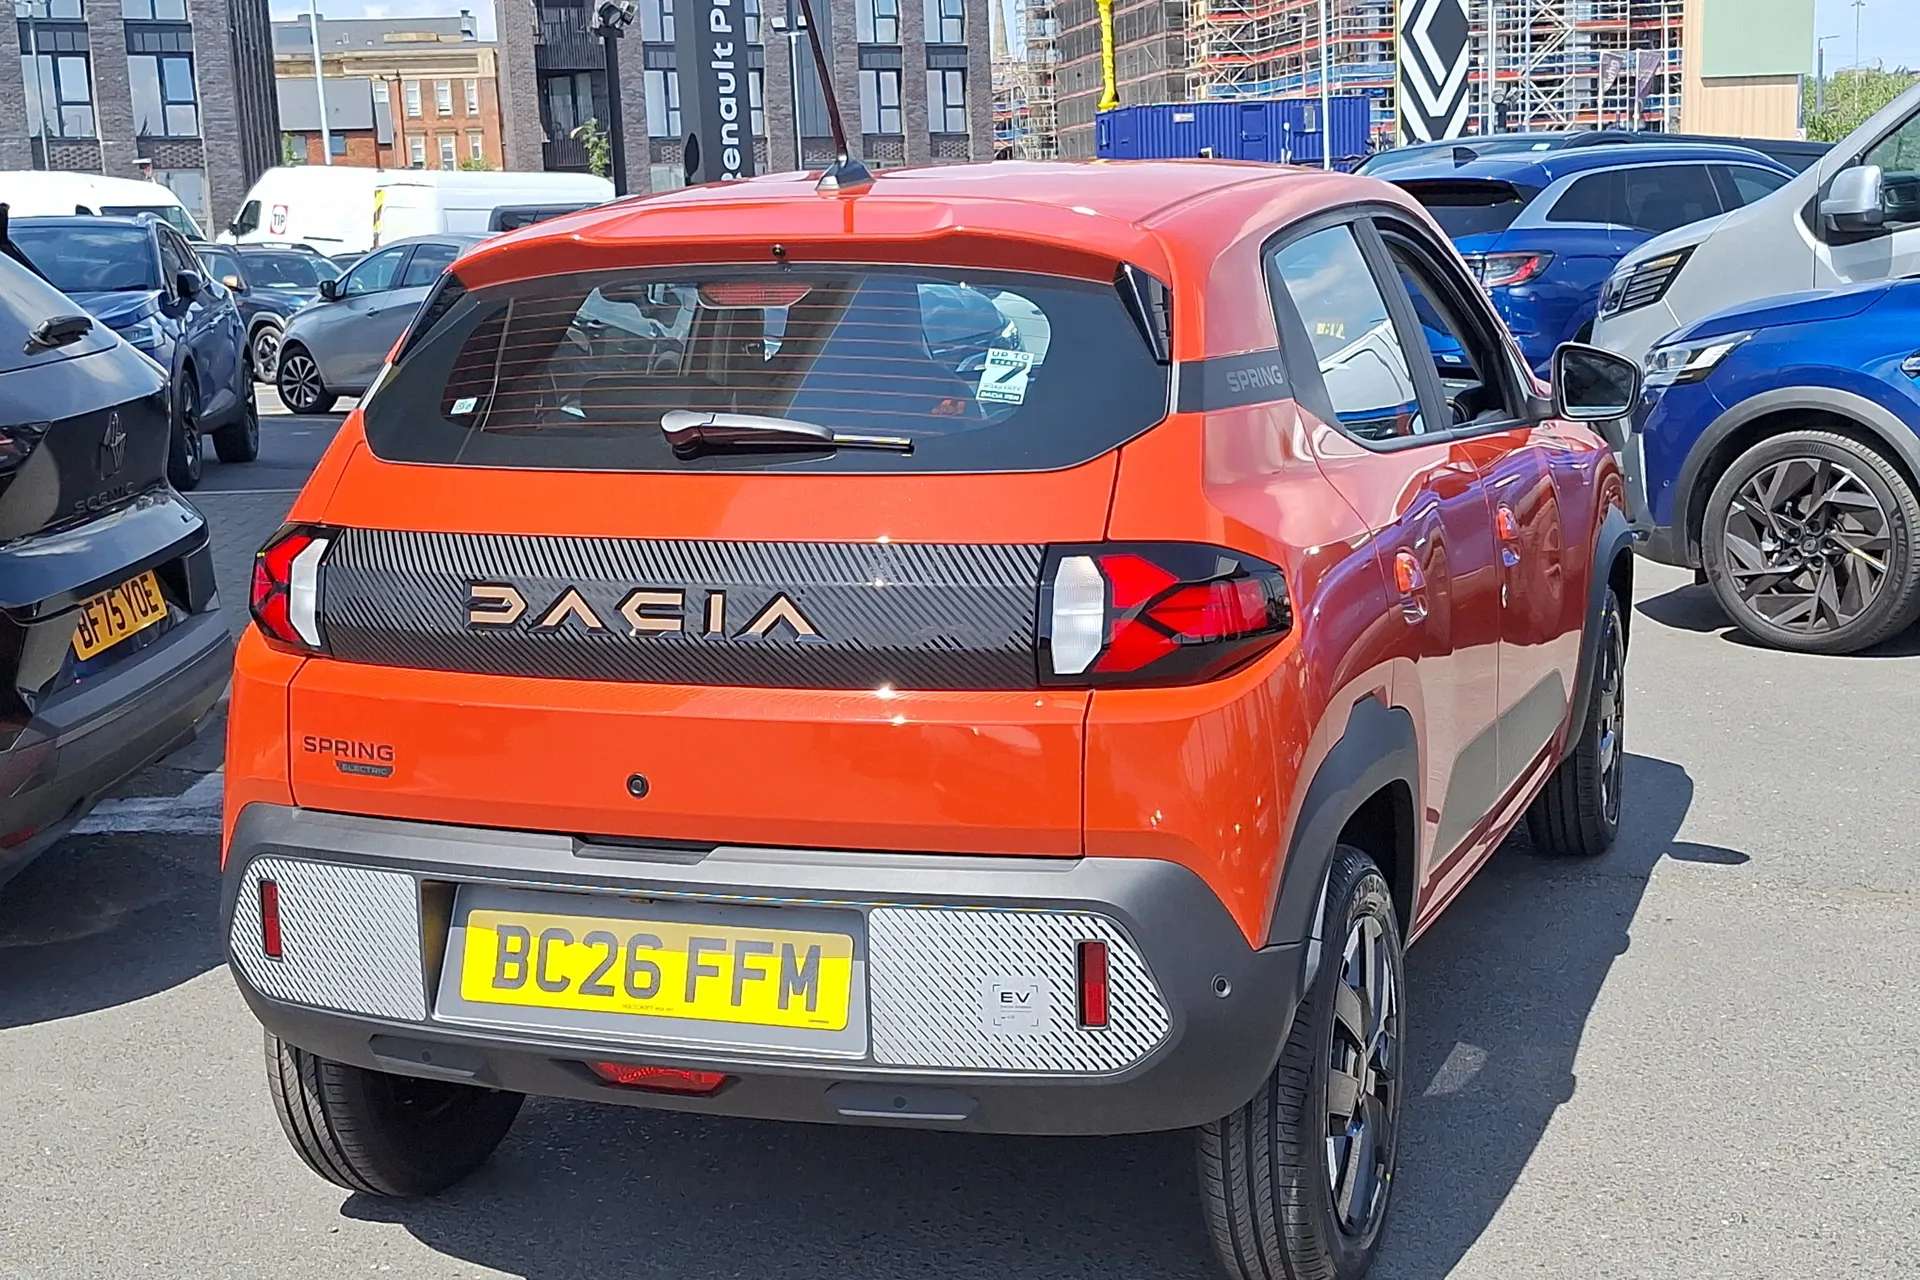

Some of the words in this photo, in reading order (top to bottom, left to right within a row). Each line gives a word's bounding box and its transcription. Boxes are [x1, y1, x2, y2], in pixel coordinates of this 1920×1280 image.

[273, 213, 286, 227] TIP
[992, 350, 1009, 358] UP
[1013, 352, 1030, 361] TO
[1226, 364, 1284, 393] SPRING
[78, 591, 126, 649] BF75
[120, 573, 160, 624] YOE
[464, 582, 826, 642] DACIA
[302, 734, 395, 762] SPRING
[491, 923, 665, 1001] BC26
[683, 936, 822, 1013] FFM
[1000, 991, 1031, 1004] EV
